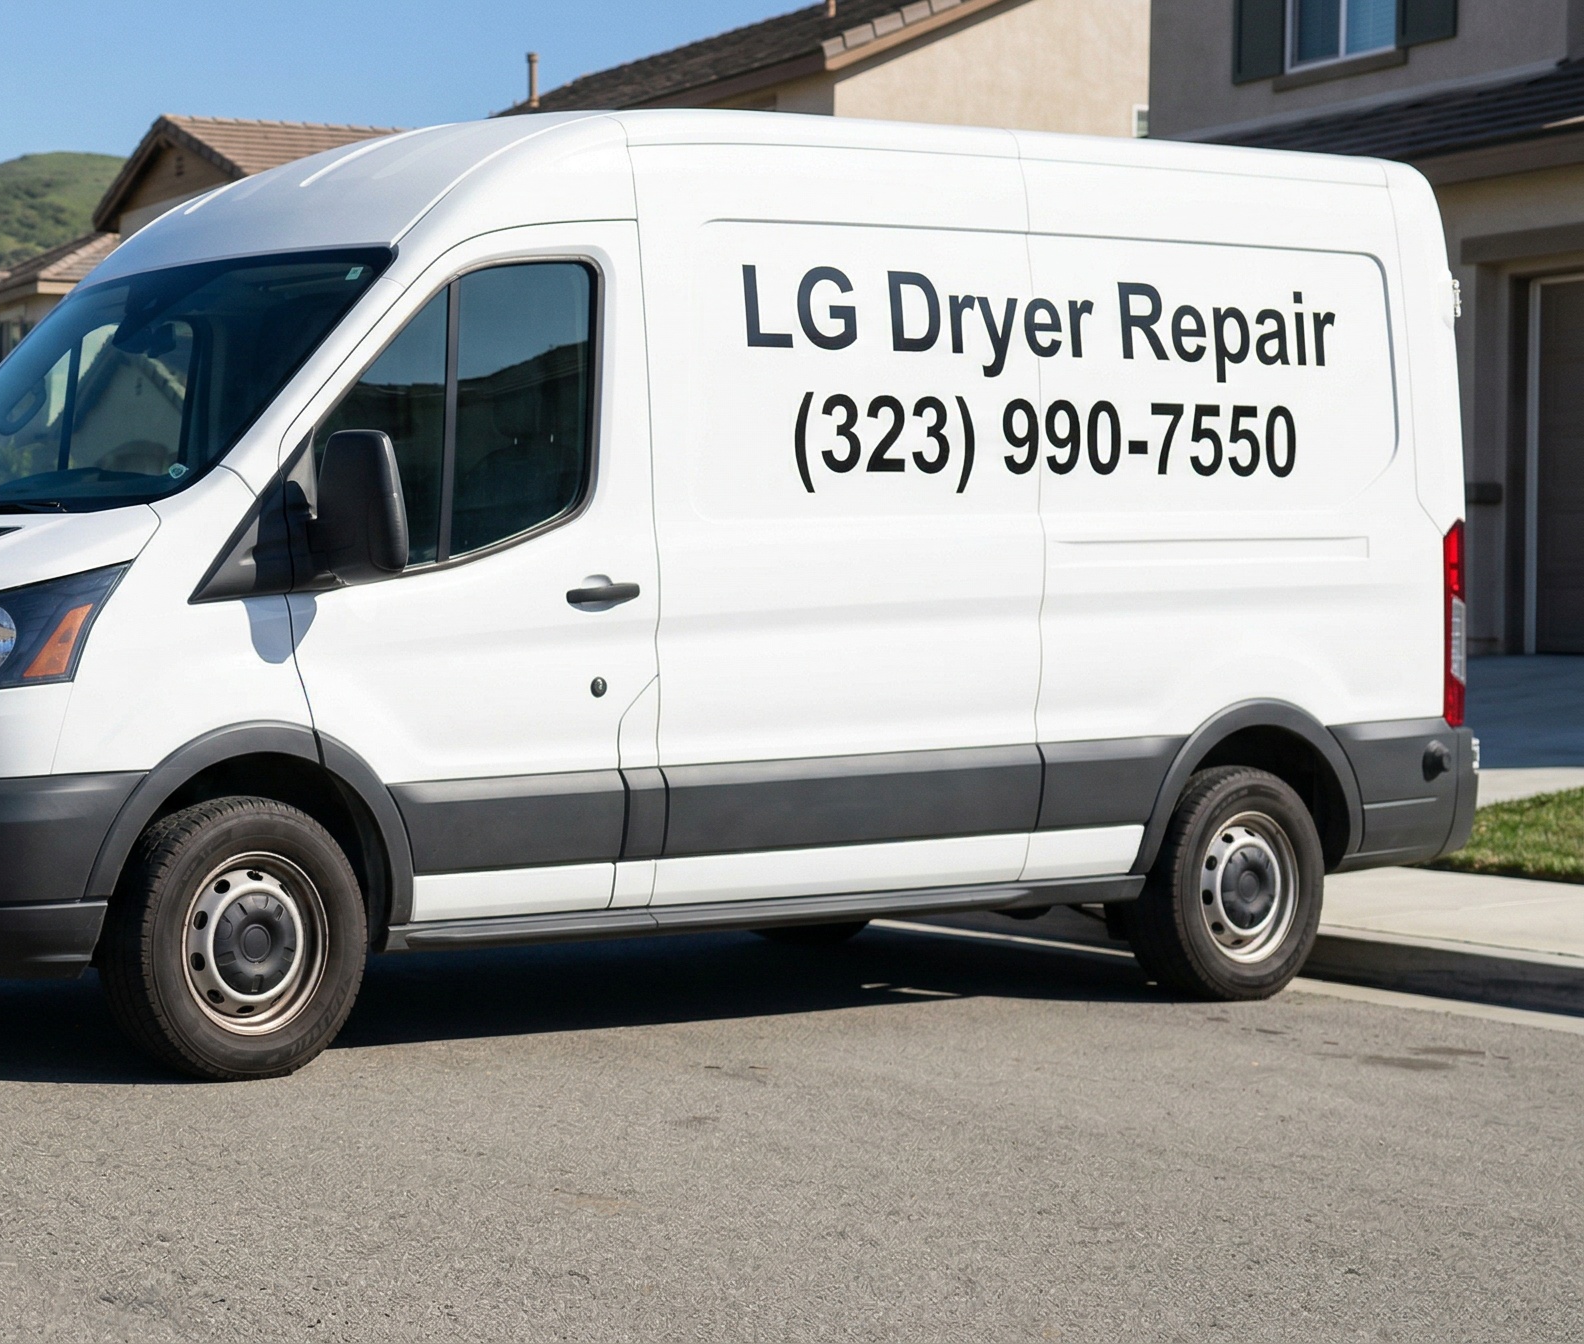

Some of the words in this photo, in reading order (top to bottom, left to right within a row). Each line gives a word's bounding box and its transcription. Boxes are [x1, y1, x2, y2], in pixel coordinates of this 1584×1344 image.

[742, 264, 858, 351] LG
[887, 270, 1094, 378] Dryer
[1117, 281, 1336, 383] Repair
[794, 391, 975, 494] (323)
[1002, 398, 1297, 478] 990-7550
